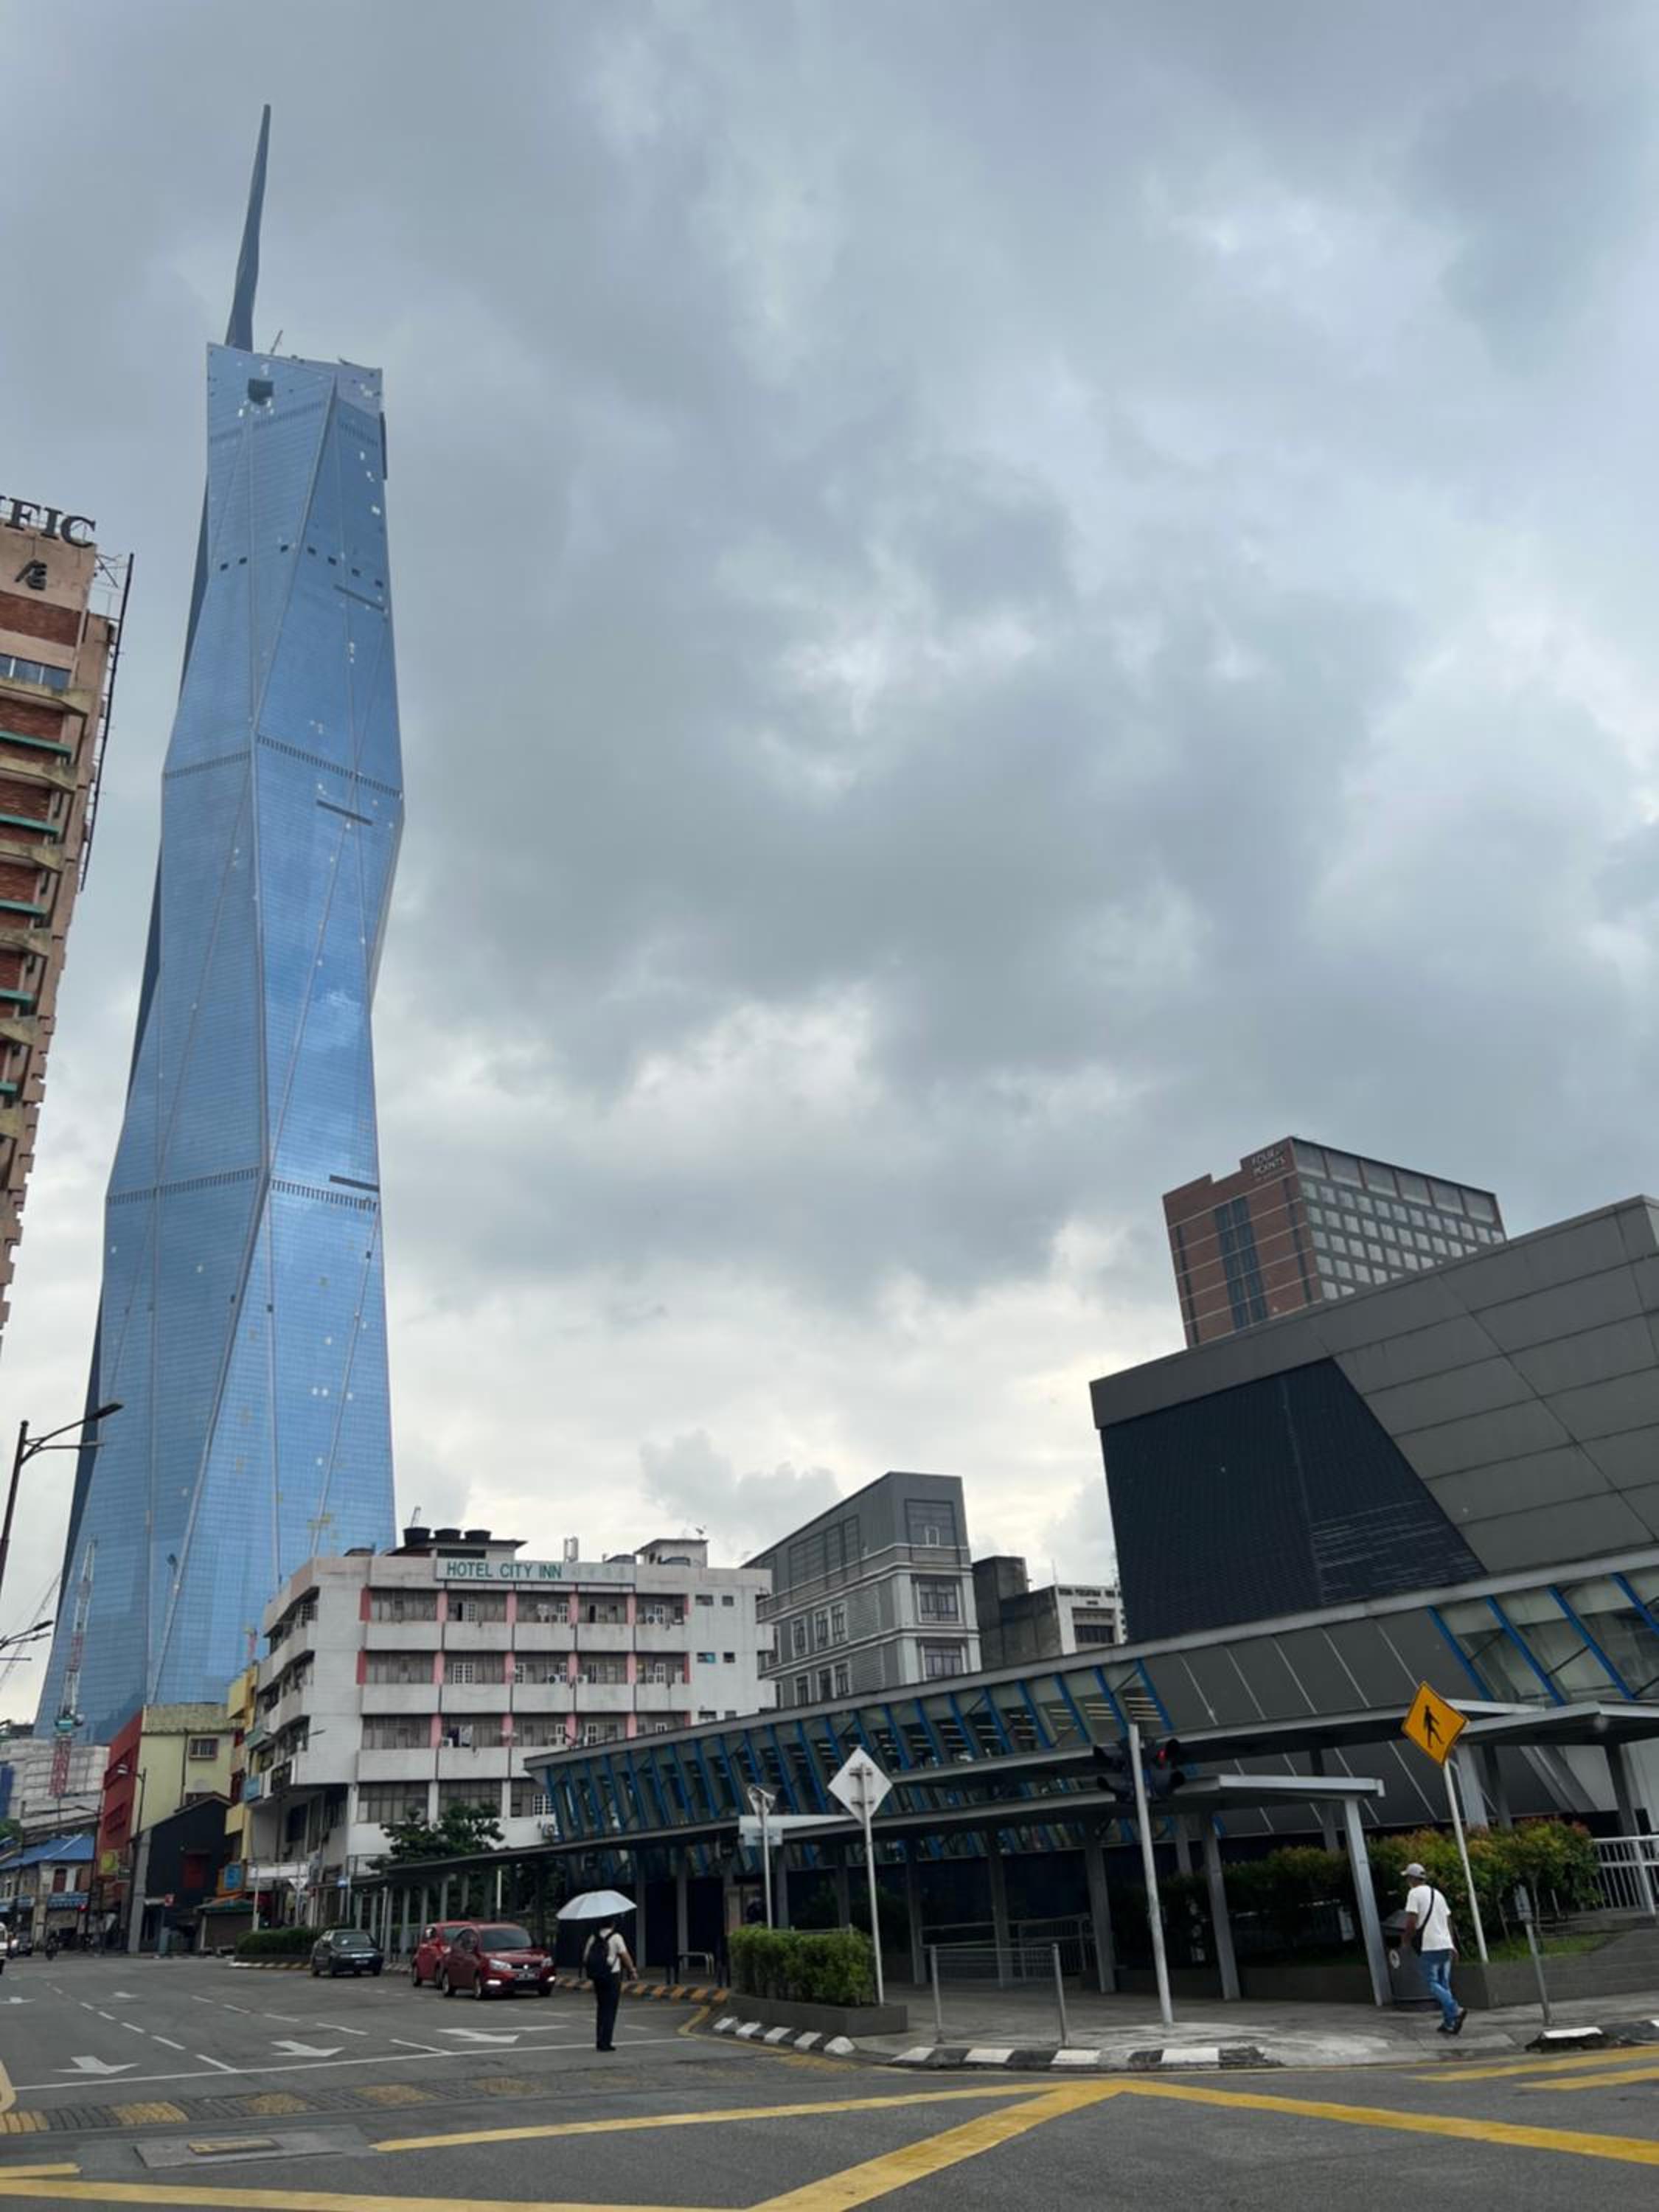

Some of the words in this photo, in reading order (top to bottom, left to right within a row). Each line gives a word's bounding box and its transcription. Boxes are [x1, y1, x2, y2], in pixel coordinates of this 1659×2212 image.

[0, 495, 96, 548] FIC
[447, 1561, 493, 1577] HOTEL
[499, 1562, 532, 1578] CITY
[539, 1564, 563, 1579] INN
